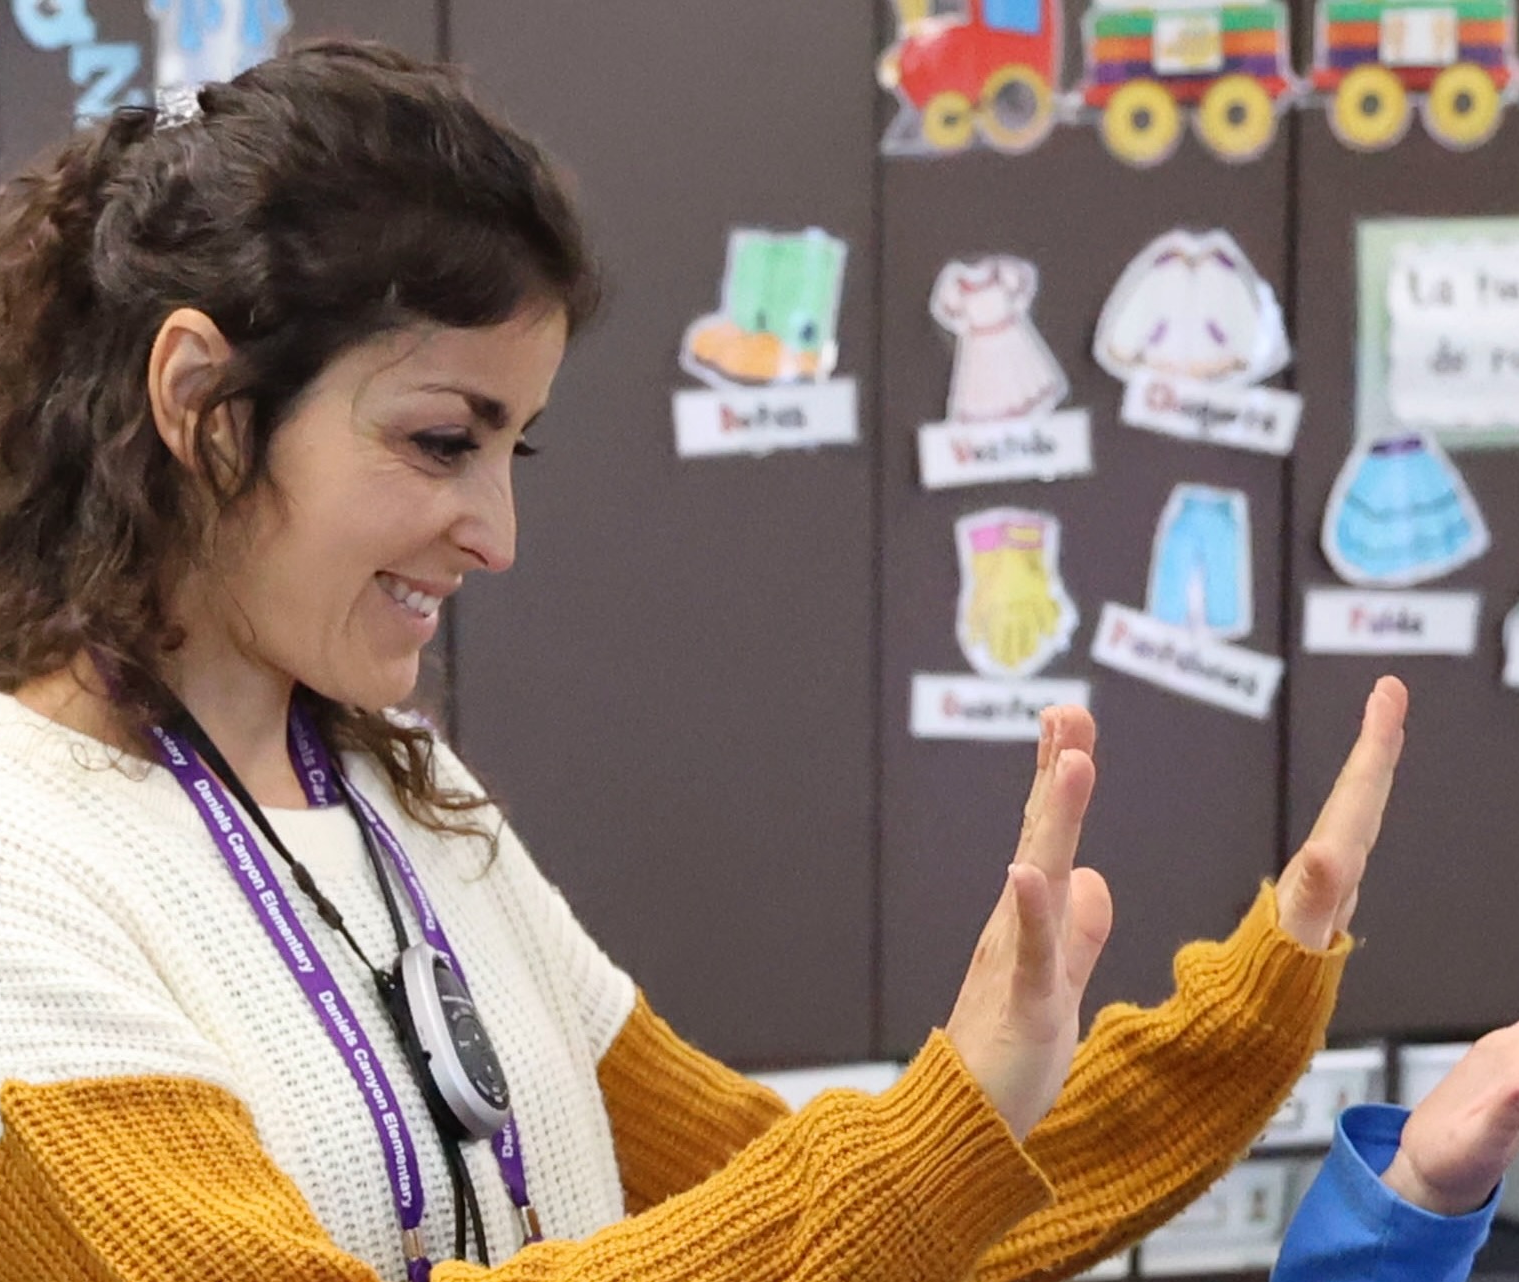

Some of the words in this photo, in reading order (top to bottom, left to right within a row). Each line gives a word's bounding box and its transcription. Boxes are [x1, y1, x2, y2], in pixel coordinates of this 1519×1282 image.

[193, 778, 233, 834] Daniels
[227, 832, 264, 891] Canyon
[259, 889, 314, 974] Elementary
[318, 990, 359, 1048] Daniels
[353, 1047, 389, 1112] Canyon
[381, 1111, 414, 1209] Elementary
